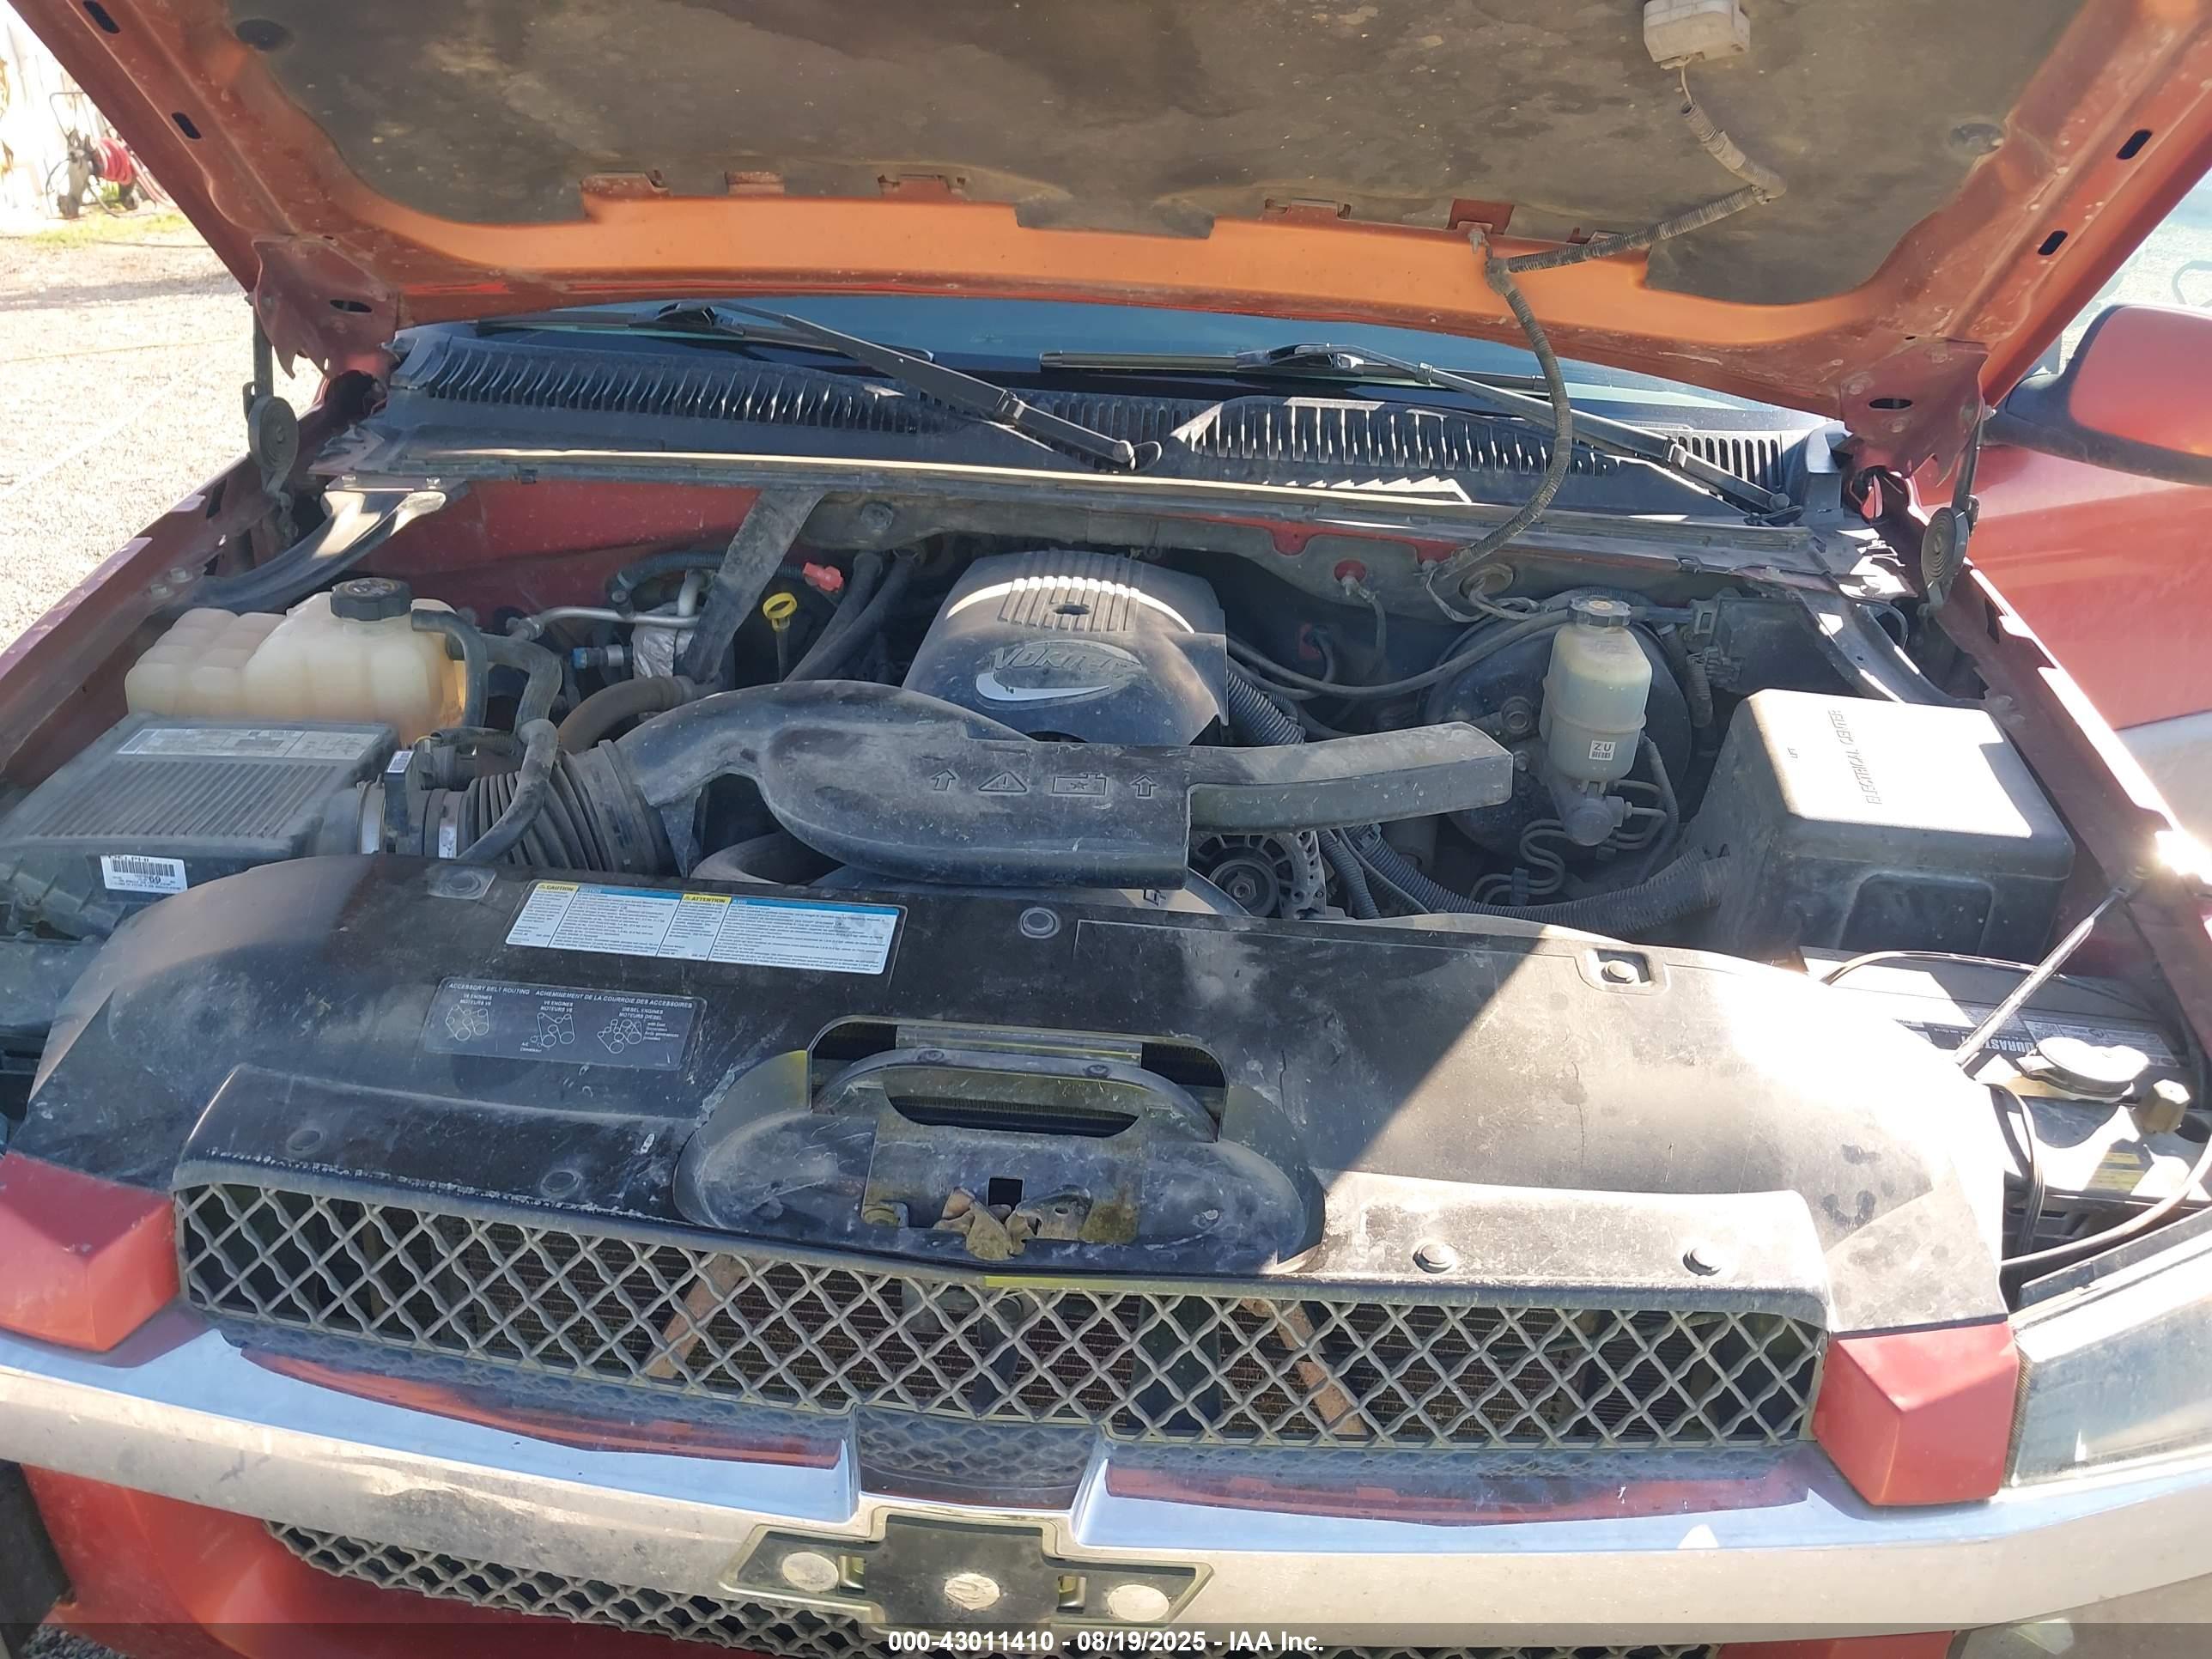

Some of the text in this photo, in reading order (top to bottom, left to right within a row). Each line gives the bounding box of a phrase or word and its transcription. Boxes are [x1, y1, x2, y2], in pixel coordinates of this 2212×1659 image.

[1827, 709, 1883, 805] ELECTRICAL CENTER
[692, 896, 726, 904] ATTENTION
[448, 982, 486, 991] ACCESSORY
[535, 990, 584, 999] ACHEMINEMENT
[603, 995, 635, 1004] COURROIE
[650, 1000, 692, 1009] ACCESSOIRES
